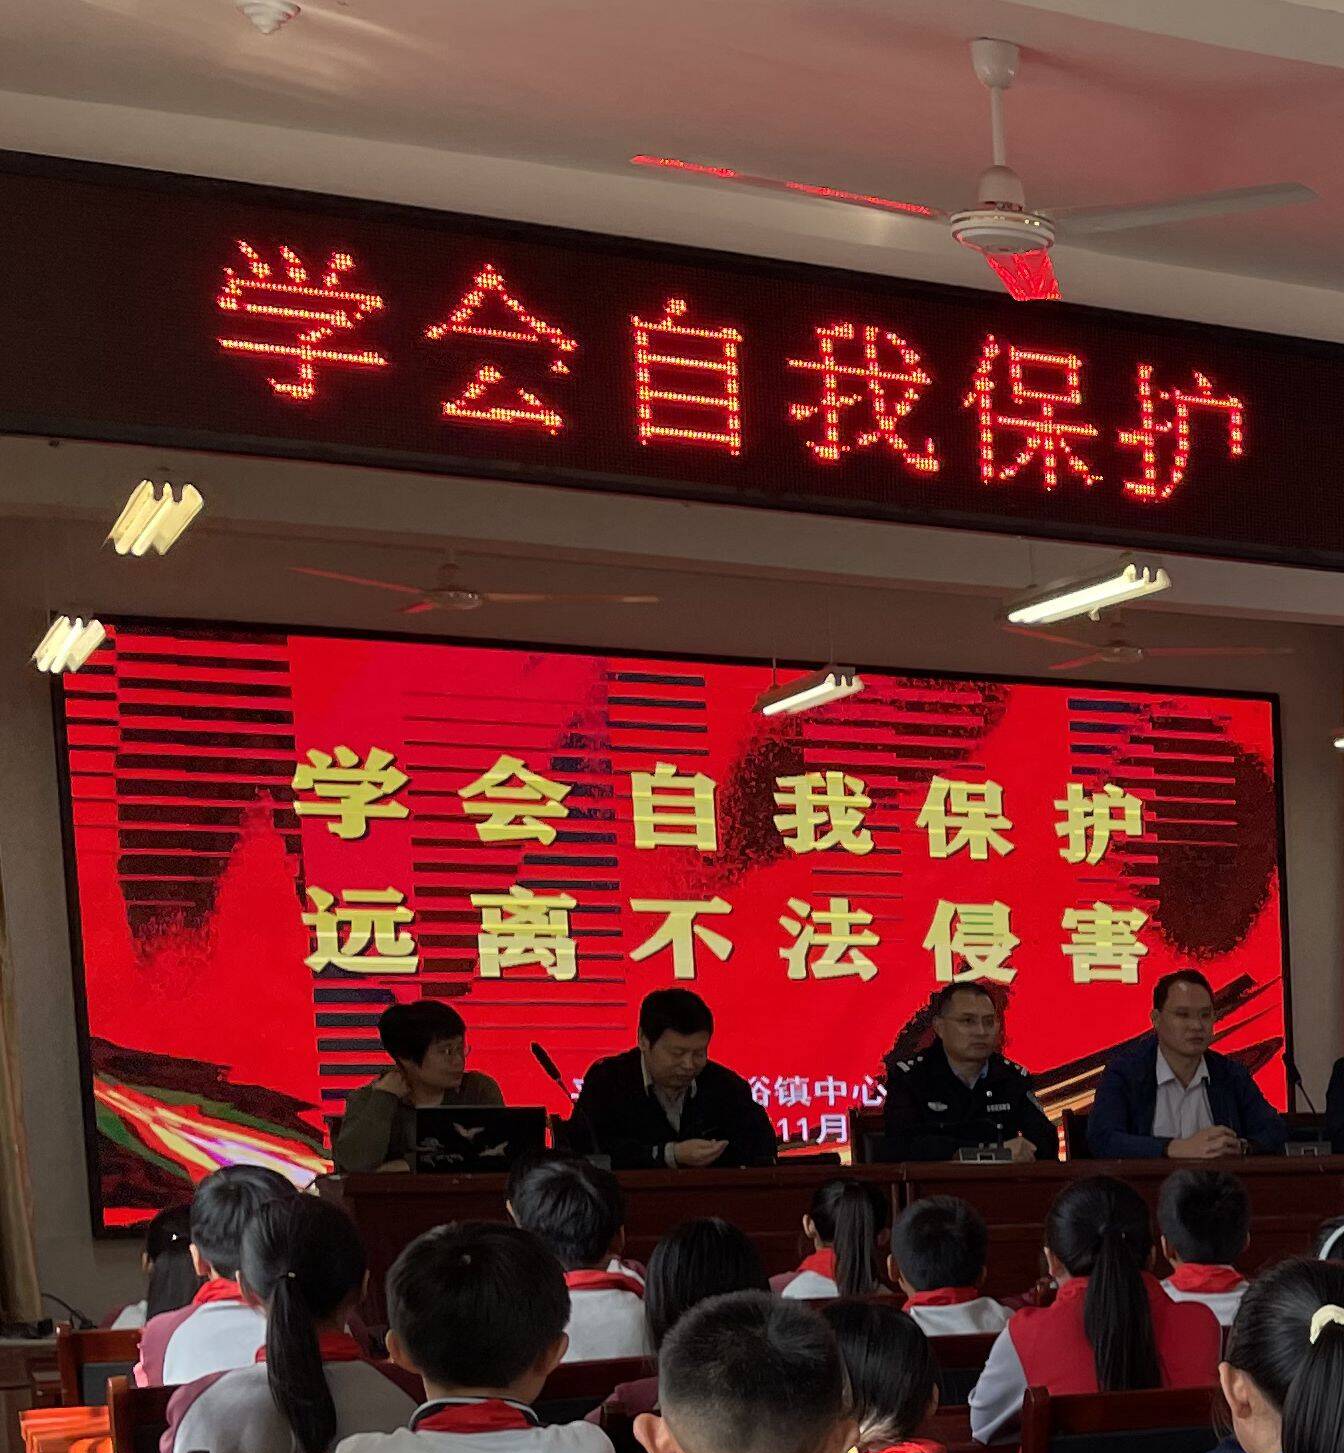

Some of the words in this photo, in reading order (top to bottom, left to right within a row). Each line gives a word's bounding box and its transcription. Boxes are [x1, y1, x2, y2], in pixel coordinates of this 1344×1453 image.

[217, 240, 1244, 502] 学会自我保护
[292, 746, 1143, 864] 学会自我保护
[302, 885, 1149, 985] 远离不法侵害
[777, 1114, 848, 1144] 11月
